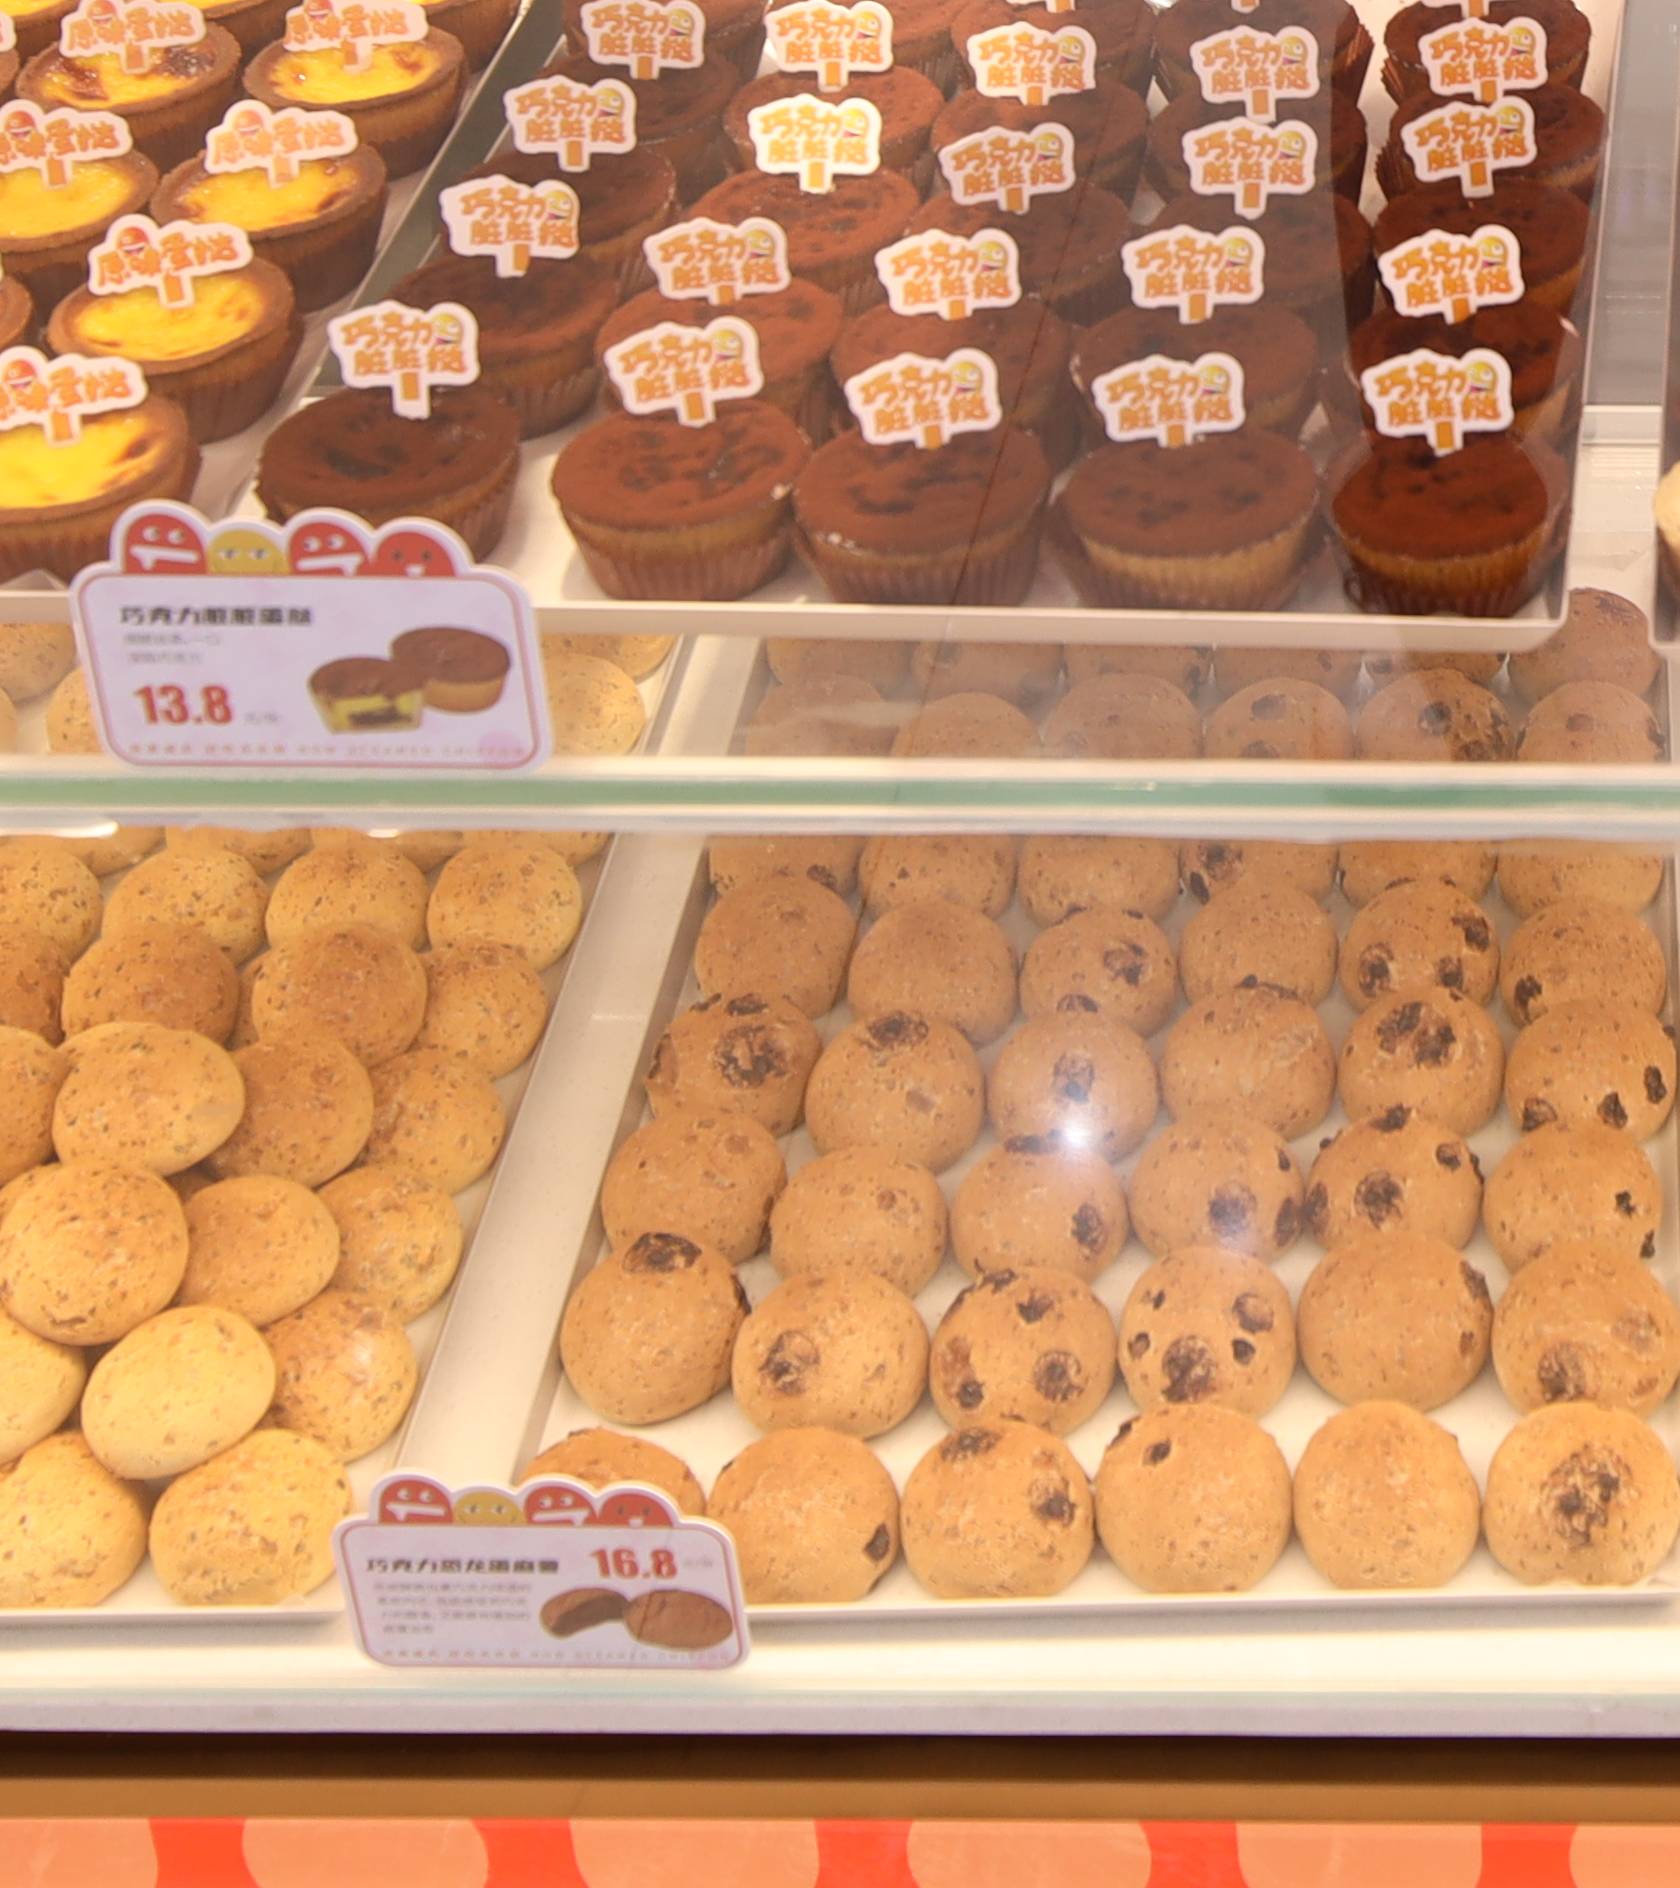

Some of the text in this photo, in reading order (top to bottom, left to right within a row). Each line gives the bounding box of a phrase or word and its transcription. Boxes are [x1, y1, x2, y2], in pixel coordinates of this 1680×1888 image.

[779, 7, 855, 37] 巧克力
[979, 33, 1056, 64] 巧克力
[1202, 36, 1279, 67] 巧克力
[1431, 28, 1509, 59] 巧克力
[517, 86, 596, 118] 巧克力
[762, 105, 841, 139] 巧克力
[1415, 110, 1495, 144] 巧克力
[954, 133, 1034, 168] 巧克力
[1196, 127, 1277, 161] 巧克力
[454, 187, 538, 225] 巧克力
[658, 230, 746, 266] 巧克力
[890, 241, 977, 278] 巧克力
[1136, 237, 1222, 272] 巧克力
[1392, 238, 1480, 276] 巧克力
[343, 312, 433, 350] 巧克力
[631, 330, 720, 373] 巧克力
[862, 361, 955, 403] 巧克力
[1108, 365, 1199, 402] 巧克力
[1377, 361, 1468, 400] 巧克力
[134, 685, 234, 726] 13.8
[590, 1548, 678, 1580] 16.8
